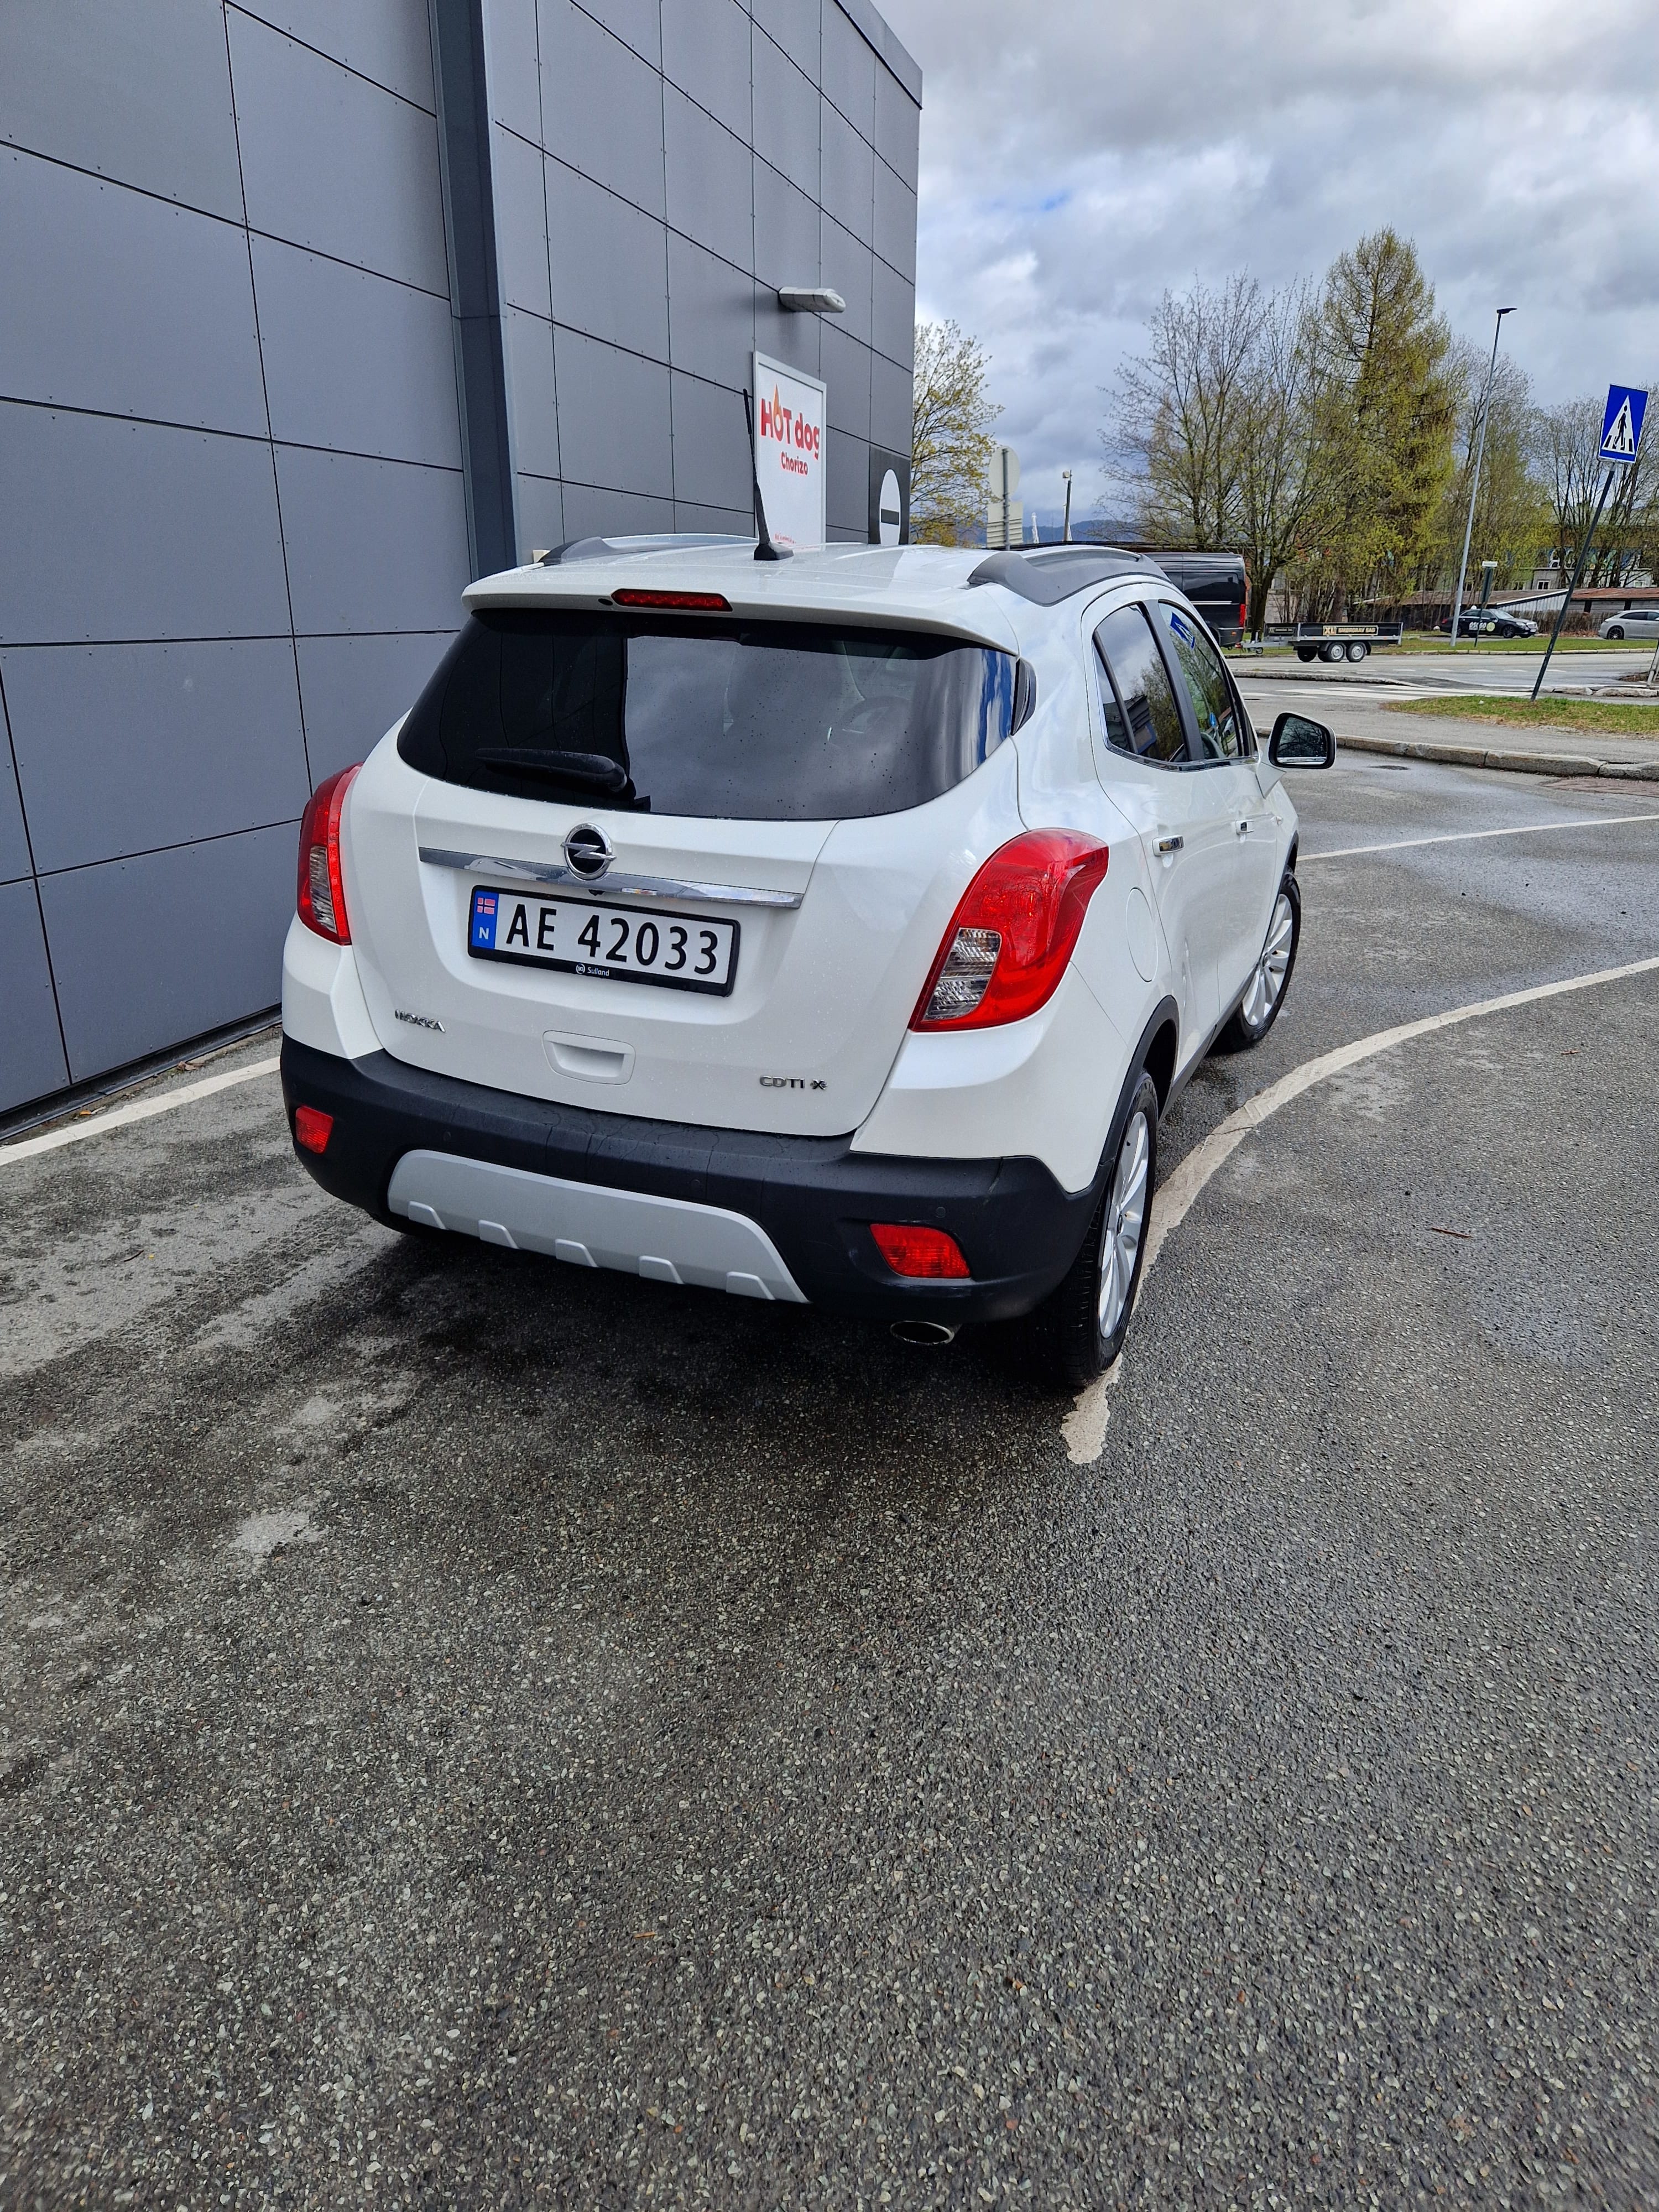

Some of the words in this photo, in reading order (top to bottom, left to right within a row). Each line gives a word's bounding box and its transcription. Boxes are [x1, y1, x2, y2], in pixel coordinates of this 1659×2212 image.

[761, 397, 792, 445] HOT
[795, 412, 821, 460] dog
[781, 451, 808, 476] Chorizo
[478, 926, 489, 940] N
[505, 903, 557, 951] AE
[577, 914, 718, 975] 42033
[587, 967, 610, 977] Sulland
[759, 1075, 805, 1089] CDTI
